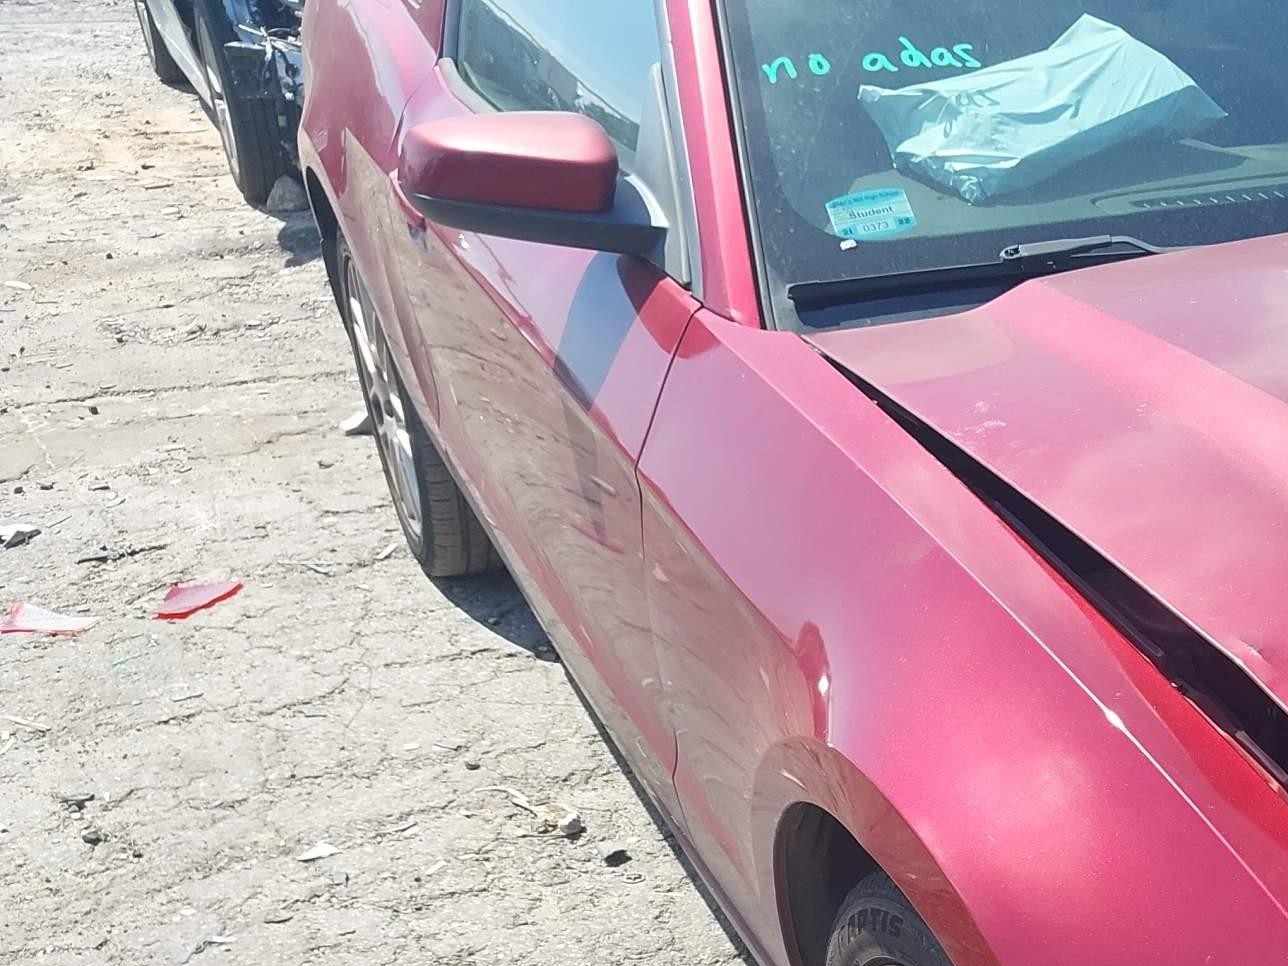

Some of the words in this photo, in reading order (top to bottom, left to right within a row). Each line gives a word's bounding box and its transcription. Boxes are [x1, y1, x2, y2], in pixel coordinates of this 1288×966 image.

[762, 54, 831, 84] no
[862, 36, 982, 72] adas
[848, 205, 894, 219] Student
[862, 221, 889, 232] 0373
